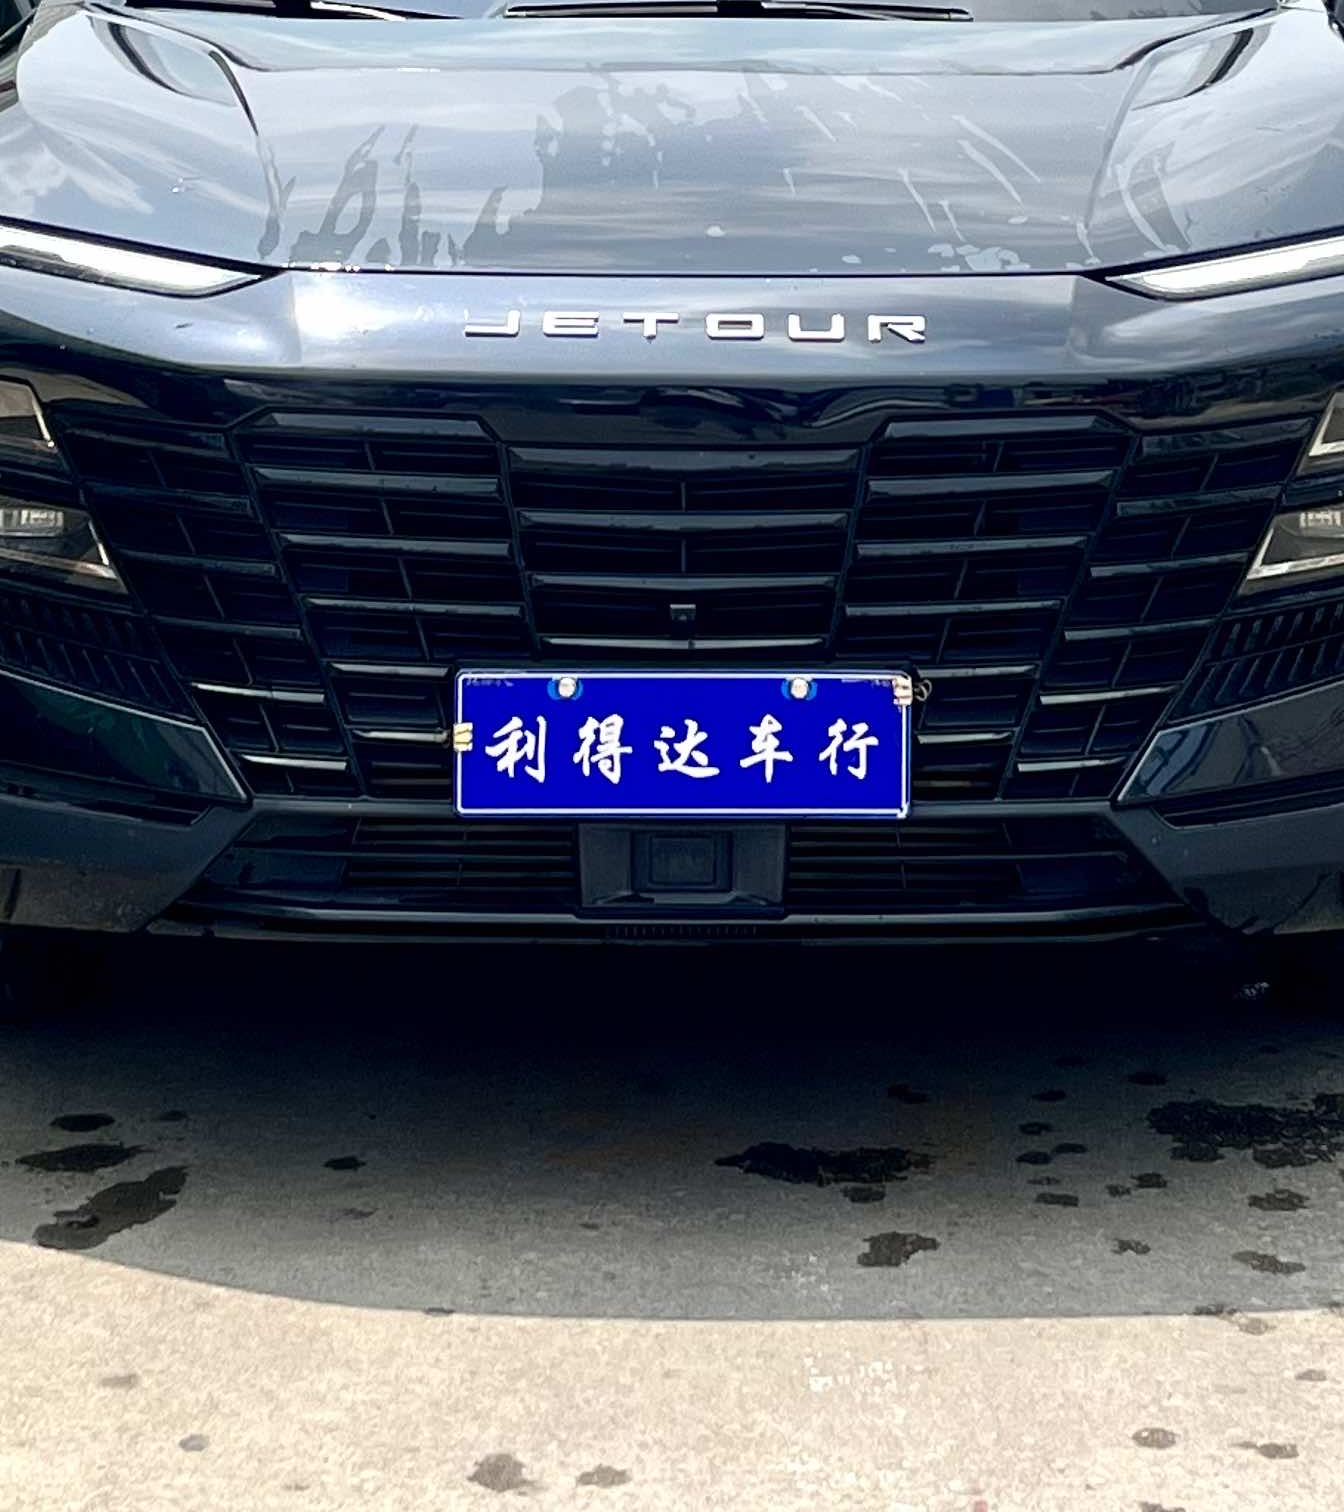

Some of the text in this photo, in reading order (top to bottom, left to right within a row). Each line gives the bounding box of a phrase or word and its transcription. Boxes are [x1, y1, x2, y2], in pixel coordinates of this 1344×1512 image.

[463, 309, 928, 343] JETOUR
[485, 713, 880, 785] 利得达车行
